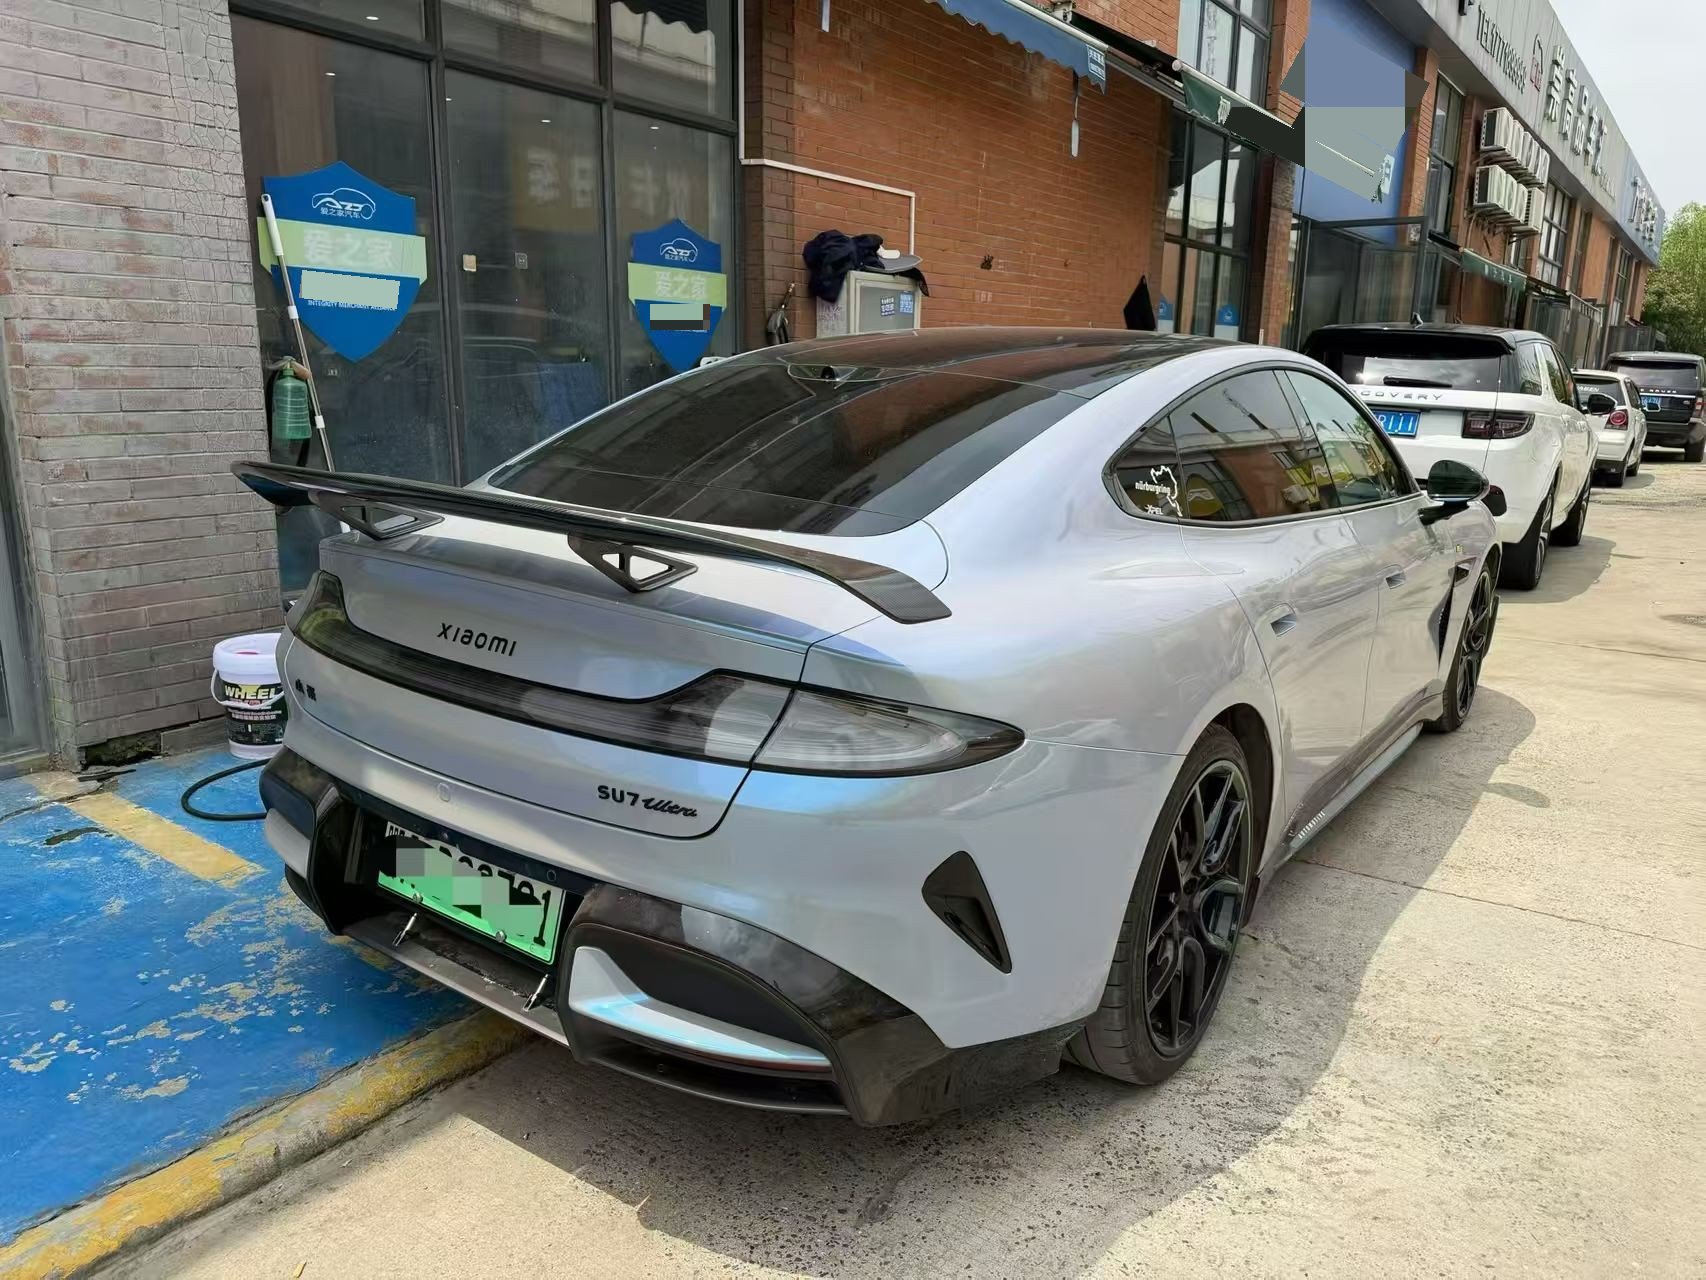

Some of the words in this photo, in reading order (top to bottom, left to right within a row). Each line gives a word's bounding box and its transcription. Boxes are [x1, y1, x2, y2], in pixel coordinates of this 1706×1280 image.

[1144, 503, 1164, 515] XPEL
[224, 685, 276, 700] WHEEL
[597, 785, 639, 807] SU7
